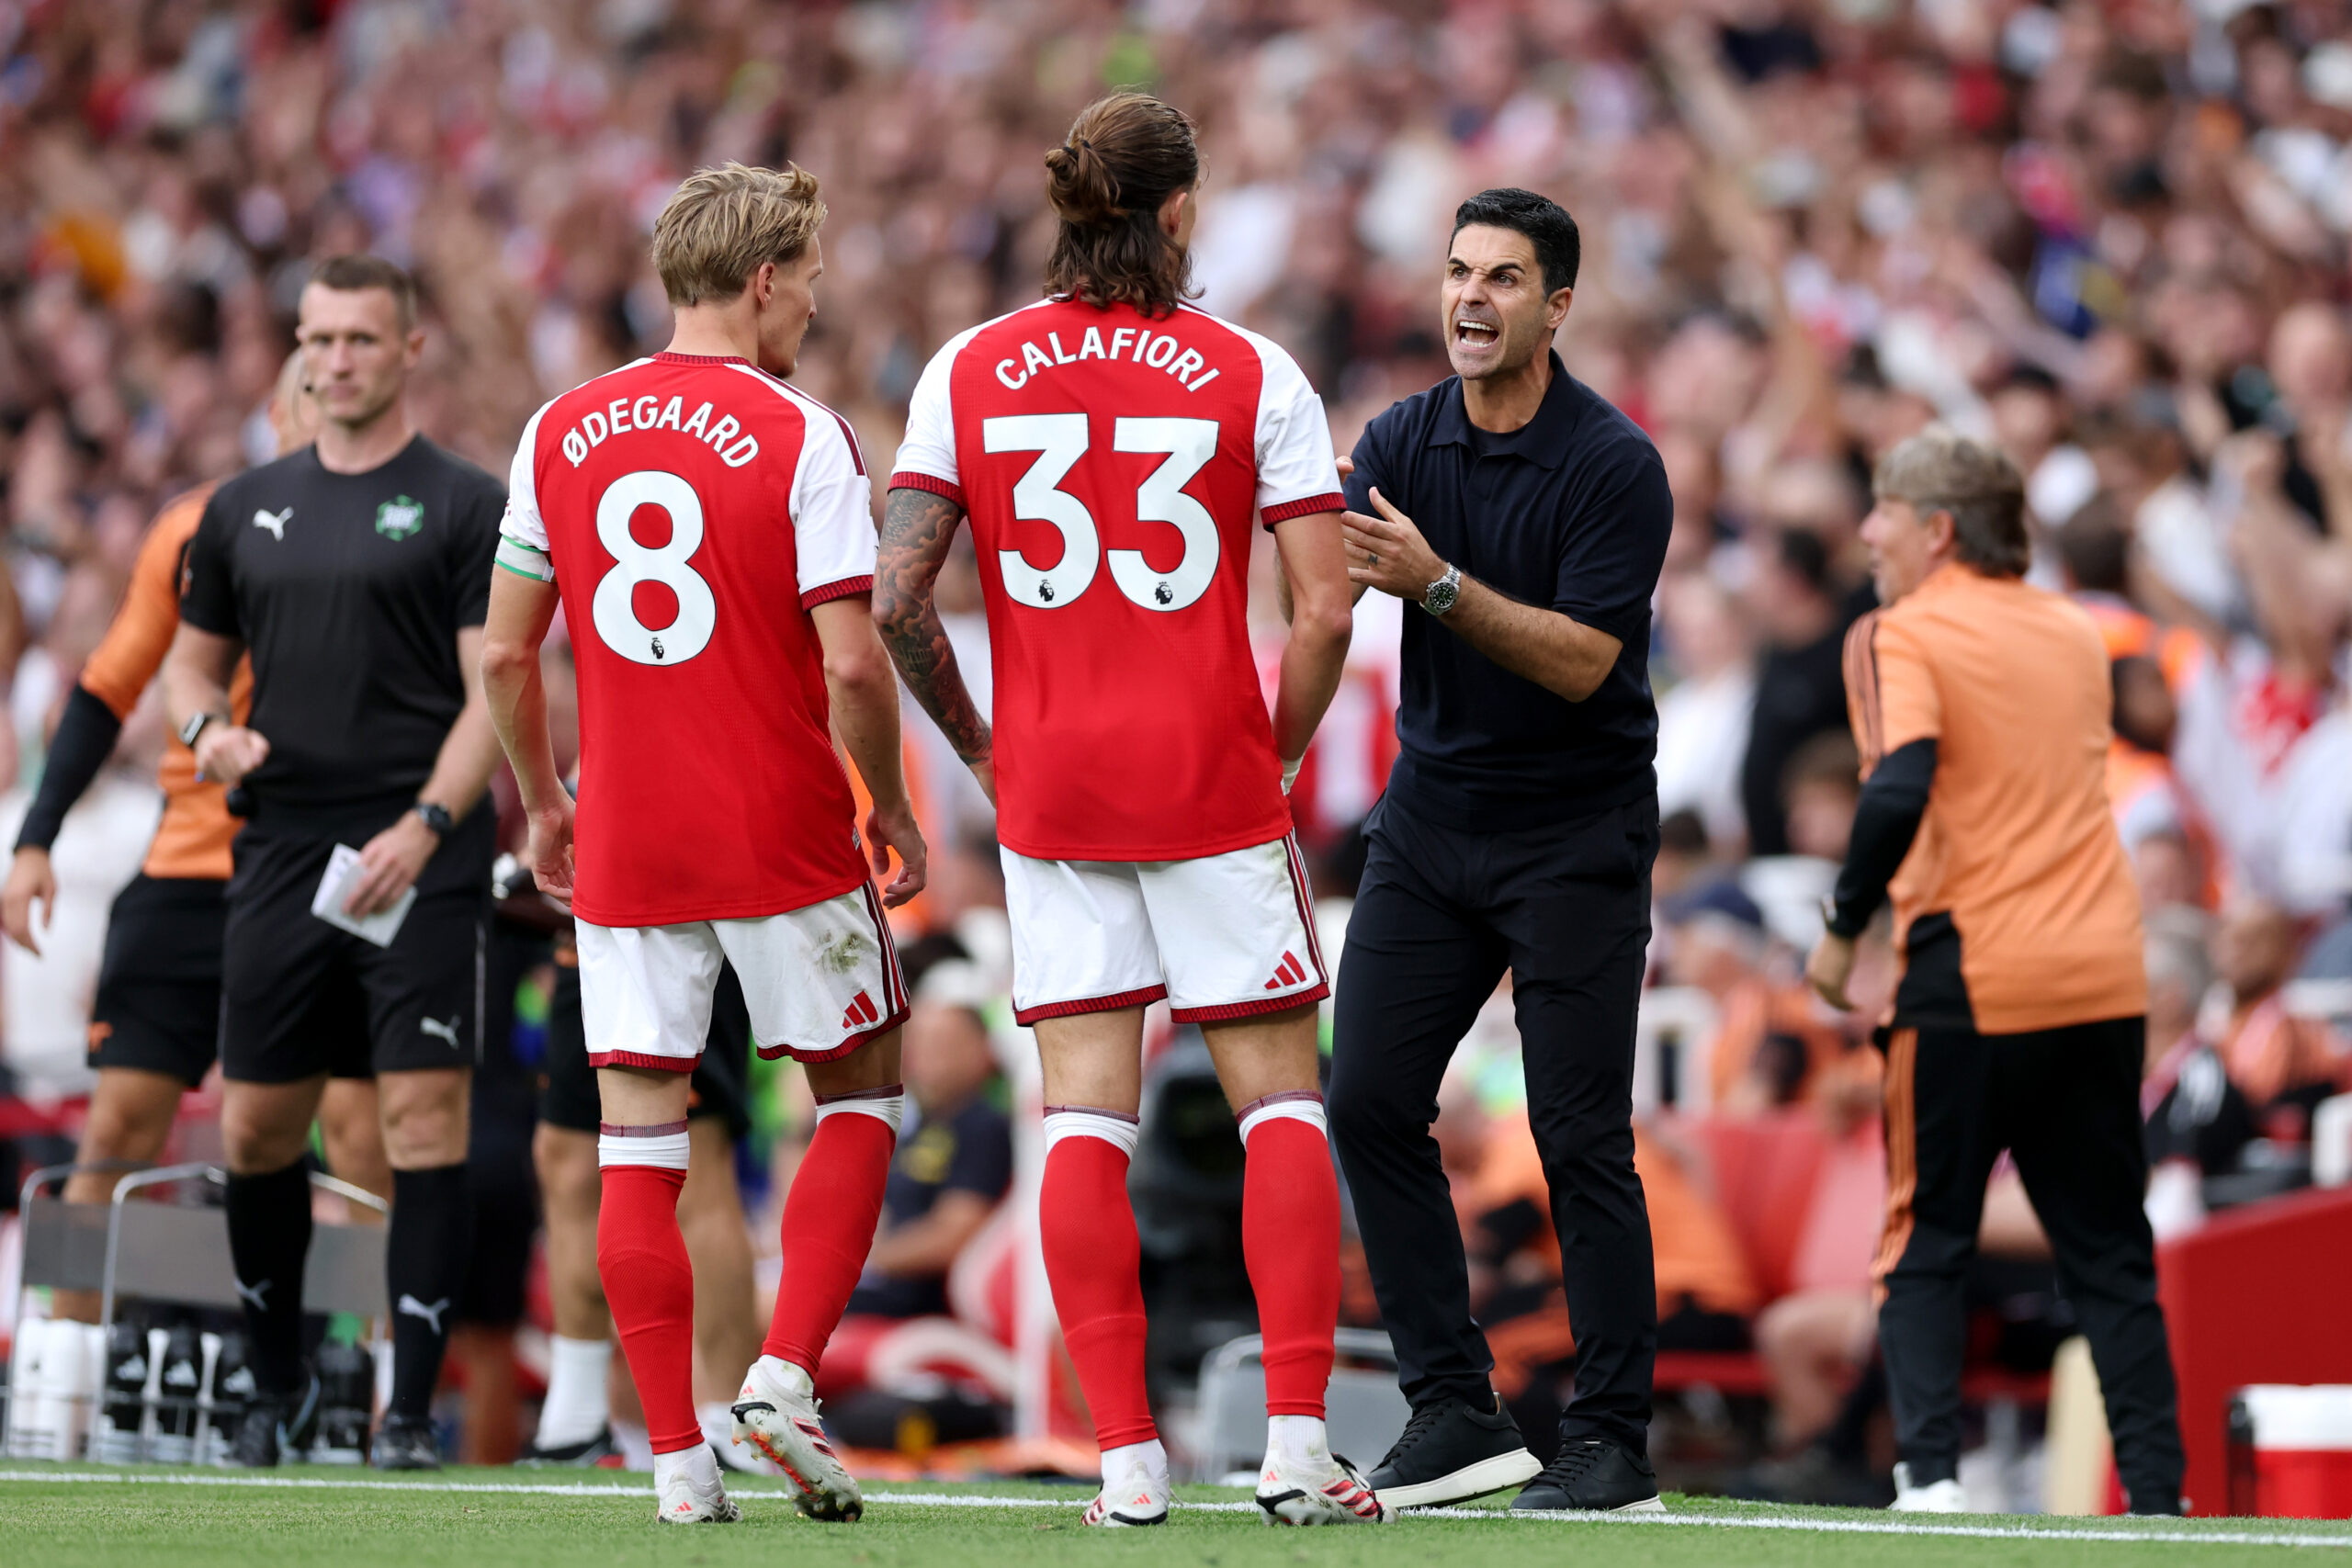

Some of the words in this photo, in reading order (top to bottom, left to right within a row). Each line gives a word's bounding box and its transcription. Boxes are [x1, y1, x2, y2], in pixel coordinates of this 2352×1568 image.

[996, 326, 1220, 392] CALAFIORI
[562, 395, 759, 468] ØDEGAARD
[592, 470, 717, 666] 8
[982, 412, 1220, 612] 33
